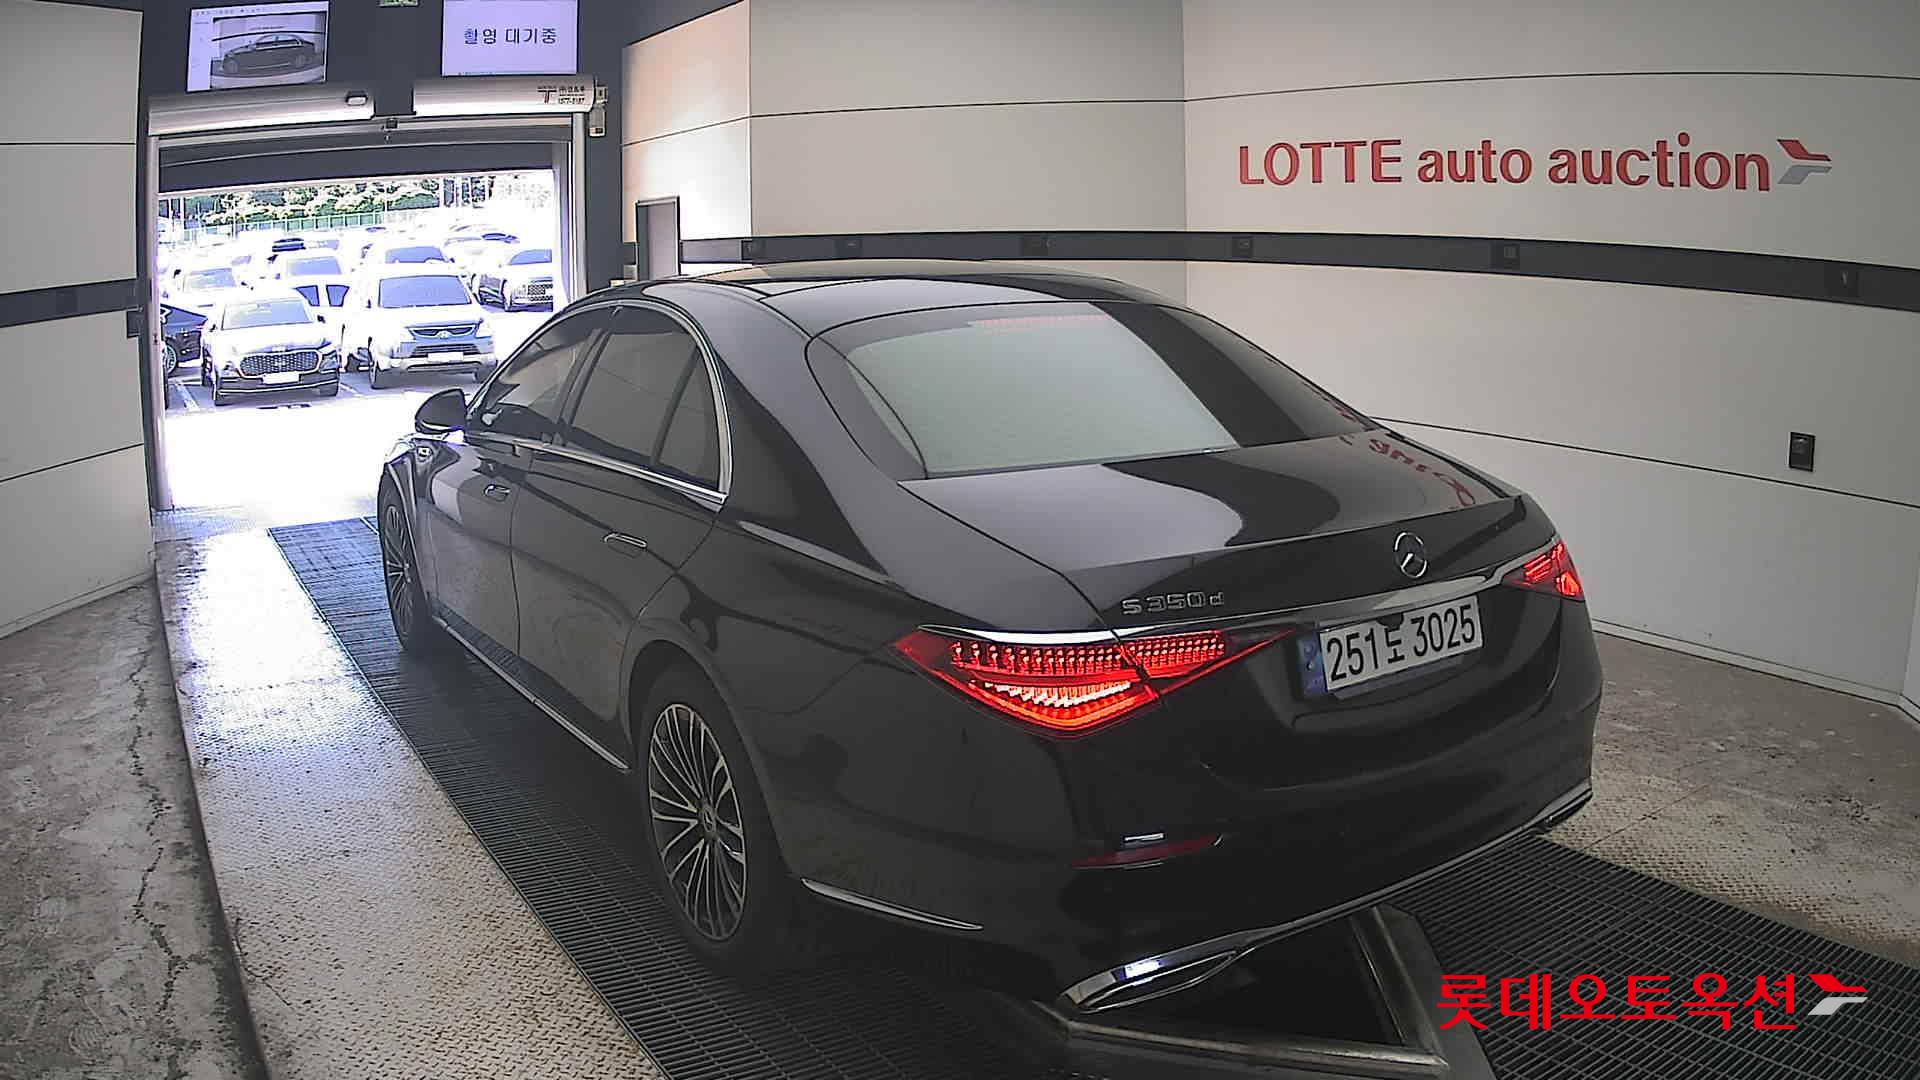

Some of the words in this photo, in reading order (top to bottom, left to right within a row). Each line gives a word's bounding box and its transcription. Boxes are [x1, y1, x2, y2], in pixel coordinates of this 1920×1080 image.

[504, 27, 557, 44] 대기중
[1239, 139, 1402, 186] LOTTE
[1417, 139, 1533, 184] auto
[1549, 132, 1771, 192] auction
